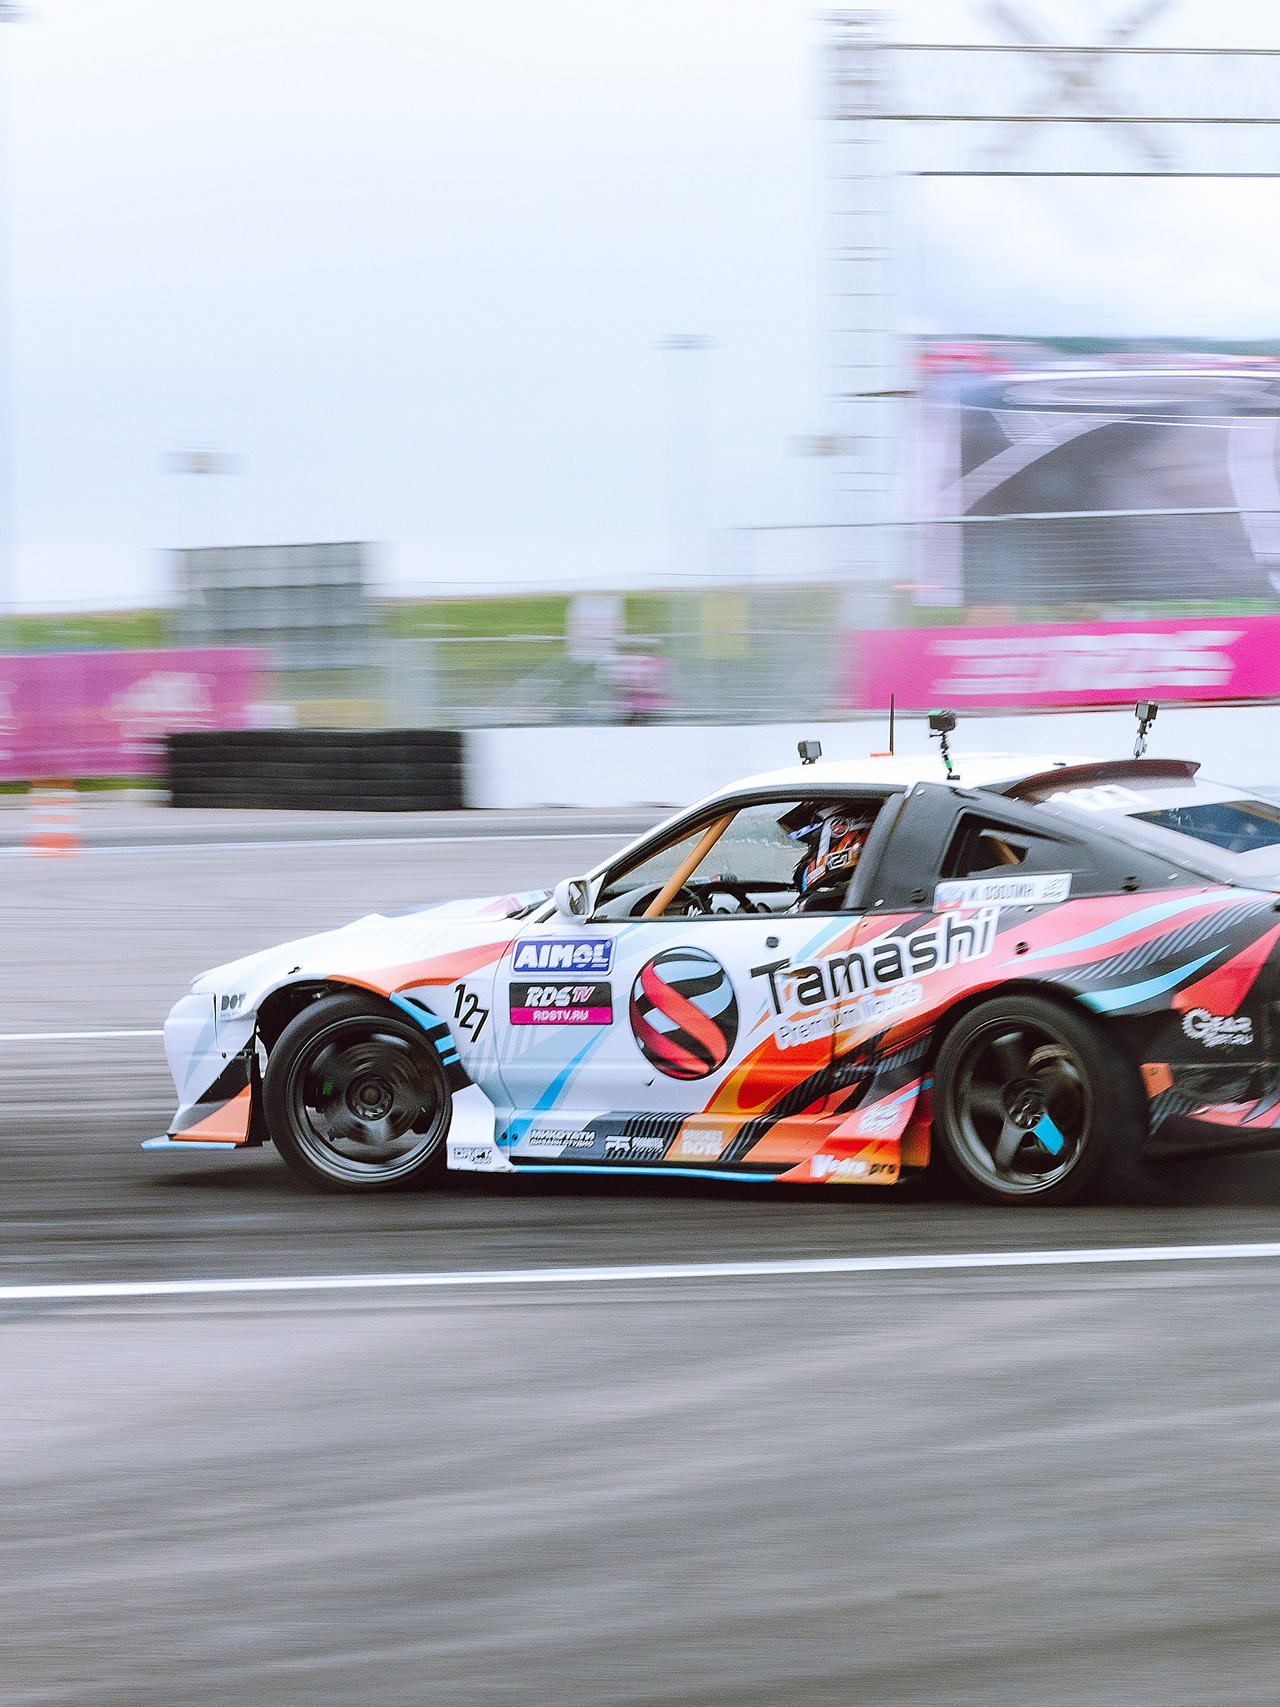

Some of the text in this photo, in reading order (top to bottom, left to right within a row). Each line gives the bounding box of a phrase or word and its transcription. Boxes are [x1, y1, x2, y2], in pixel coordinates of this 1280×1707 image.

[513, 943, 611, 969] AIMOL
[750, 909, 998, 1016] Tamashi
[453, 983, 490, 1043] 127
[532, 1010, 589, 1022] RDSTV.RU
